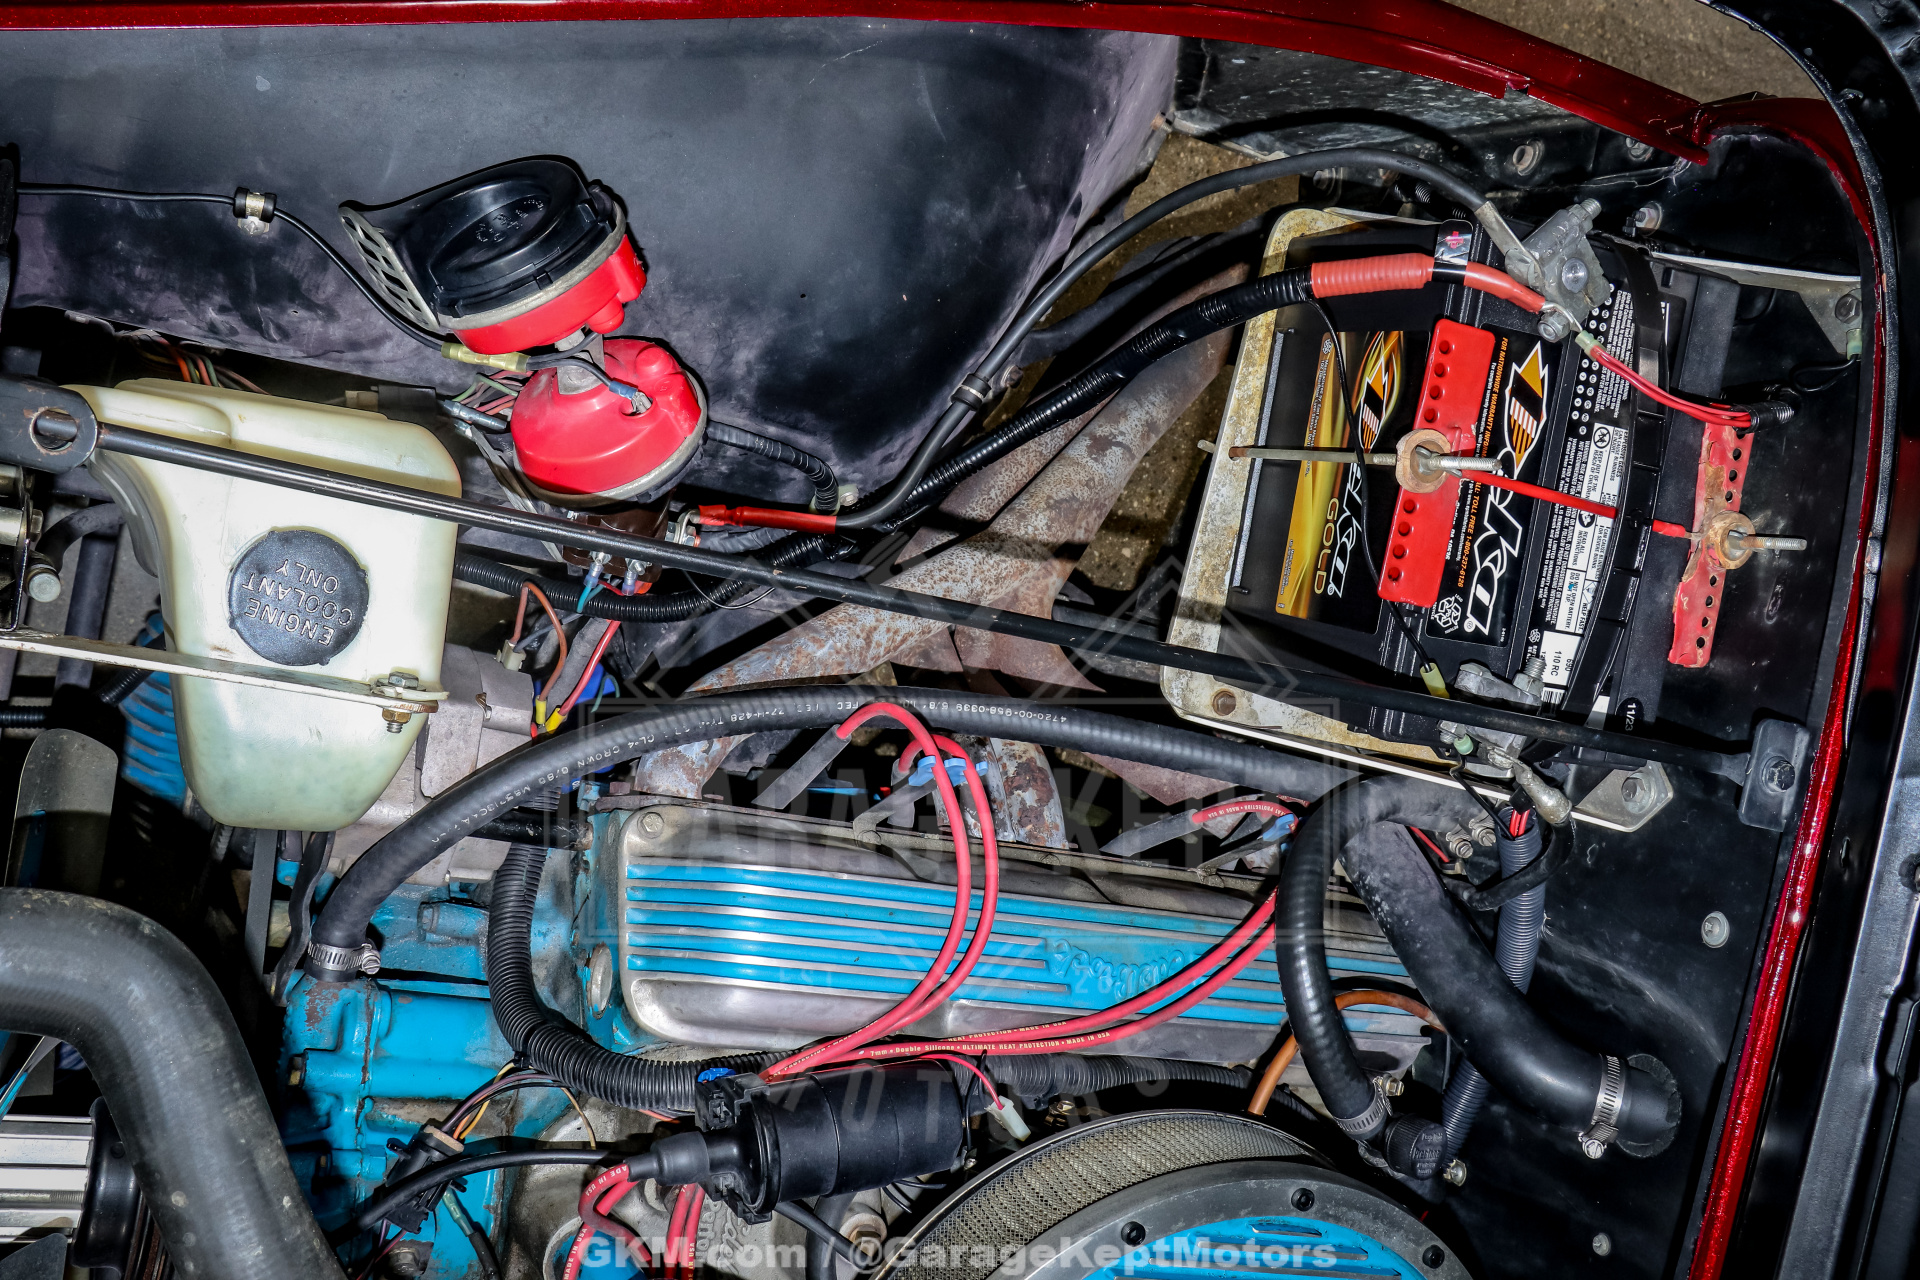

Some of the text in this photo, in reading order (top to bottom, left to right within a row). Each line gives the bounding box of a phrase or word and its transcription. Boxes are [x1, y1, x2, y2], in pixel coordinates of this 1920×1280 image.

[1500, 336, 1508, 350] FOR
[1492, 350, 1505, 392] NATIONWIDE
[1485, 393, 1497, 430] WARRANTY
[1470, 495, 1479, 513] TOLL
[1466, 514, 1475, 534] FREE
[1312, 496, 1339, 595] GOLD
[1457, 535, 1471, 587] 1-800-237-6126
[275, 559, 338, 593] ONLY
[1569, 571, 1575, 580] DO
[1574, 572, 1580, 580] DO
[242, 572, 352, 625] COOLANT
[244, 598, 334, 646] ENGINE
[1564, 606, 1573, 629] BATTERY.
[1550, 650, 1561, 676] 110 RC
[1624, 702, 1636, 730] 11/23
[575, 744, 620, 768] CROWN
[869, 1048, 888, 1056] 7mm
[894, 1045, 922, 1053] Double
[923, 1044, 955, 1052] Silicone
[961, 1041, 995, 1052] ULTIMATE
[998, 1042, 1016, 1050] HEAT
[1019, 1039, 1059, 1049] PROTECTION
[584, 1165, 628, 1197] ADE IN USA
[560, 1226, 587, 1280] MADE IN USA
